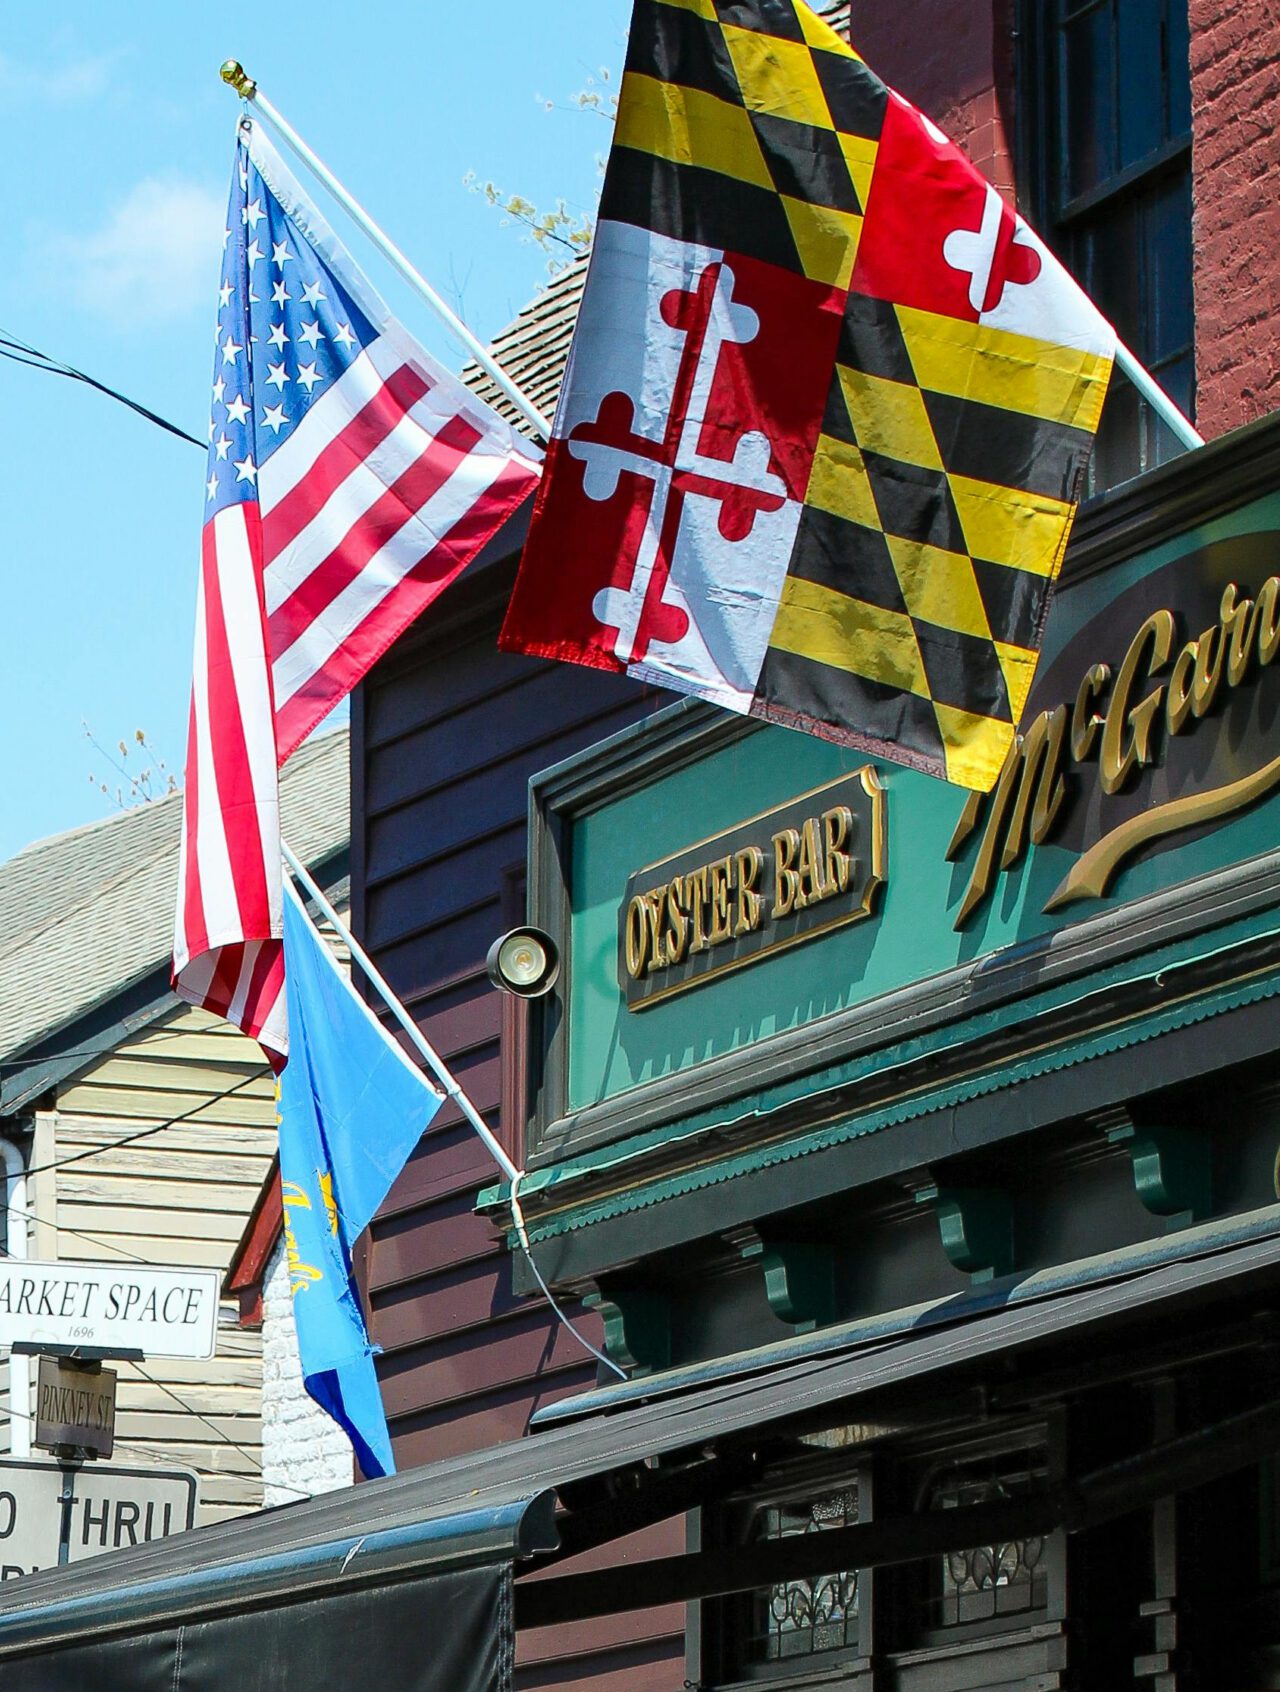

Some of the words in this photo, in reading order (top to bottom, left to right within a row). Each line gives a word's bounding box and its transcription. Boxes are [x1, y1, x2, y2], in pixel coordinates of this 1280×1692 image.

[625, 846, 764, 979] OYSTER
[771, 806, 853, 920] BAR
[104, 1283, 203, 1324] SPACE
[67, 1325, 96, 1339] 1696
[40, 1384, 95, 1428] PINKNEY
